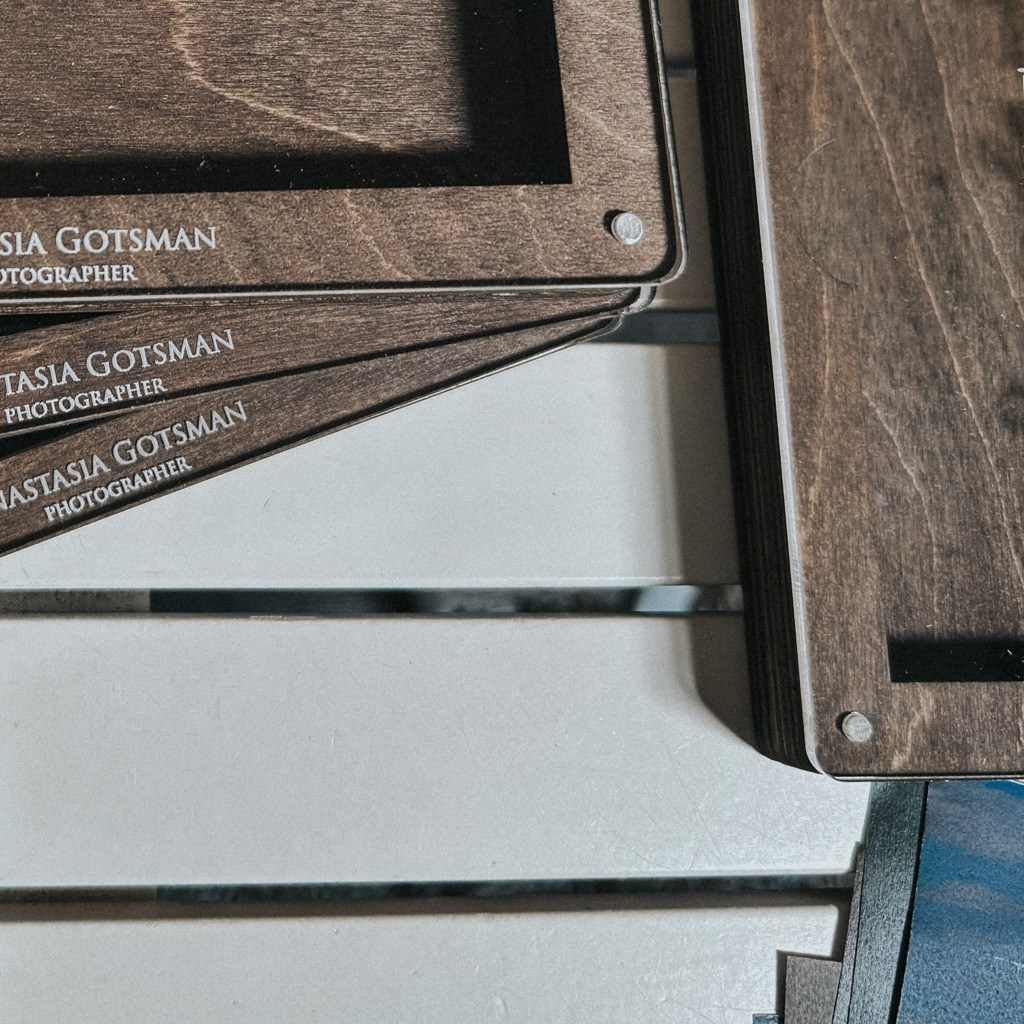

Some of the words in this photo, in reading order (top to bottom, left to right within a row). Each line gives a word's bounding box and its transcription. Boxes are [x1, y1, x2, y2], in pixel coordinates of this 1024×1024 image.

[55, 226, 217, 254] GOTSMAN
[86, 329, 236, 377] GOTSMAN
[3, 377, 168, 424] PHOTOGRAPHER
[112, 400, 249, 465] GOTSMAN
[44, 456, 193, 522] PHOTOGRAPHER
